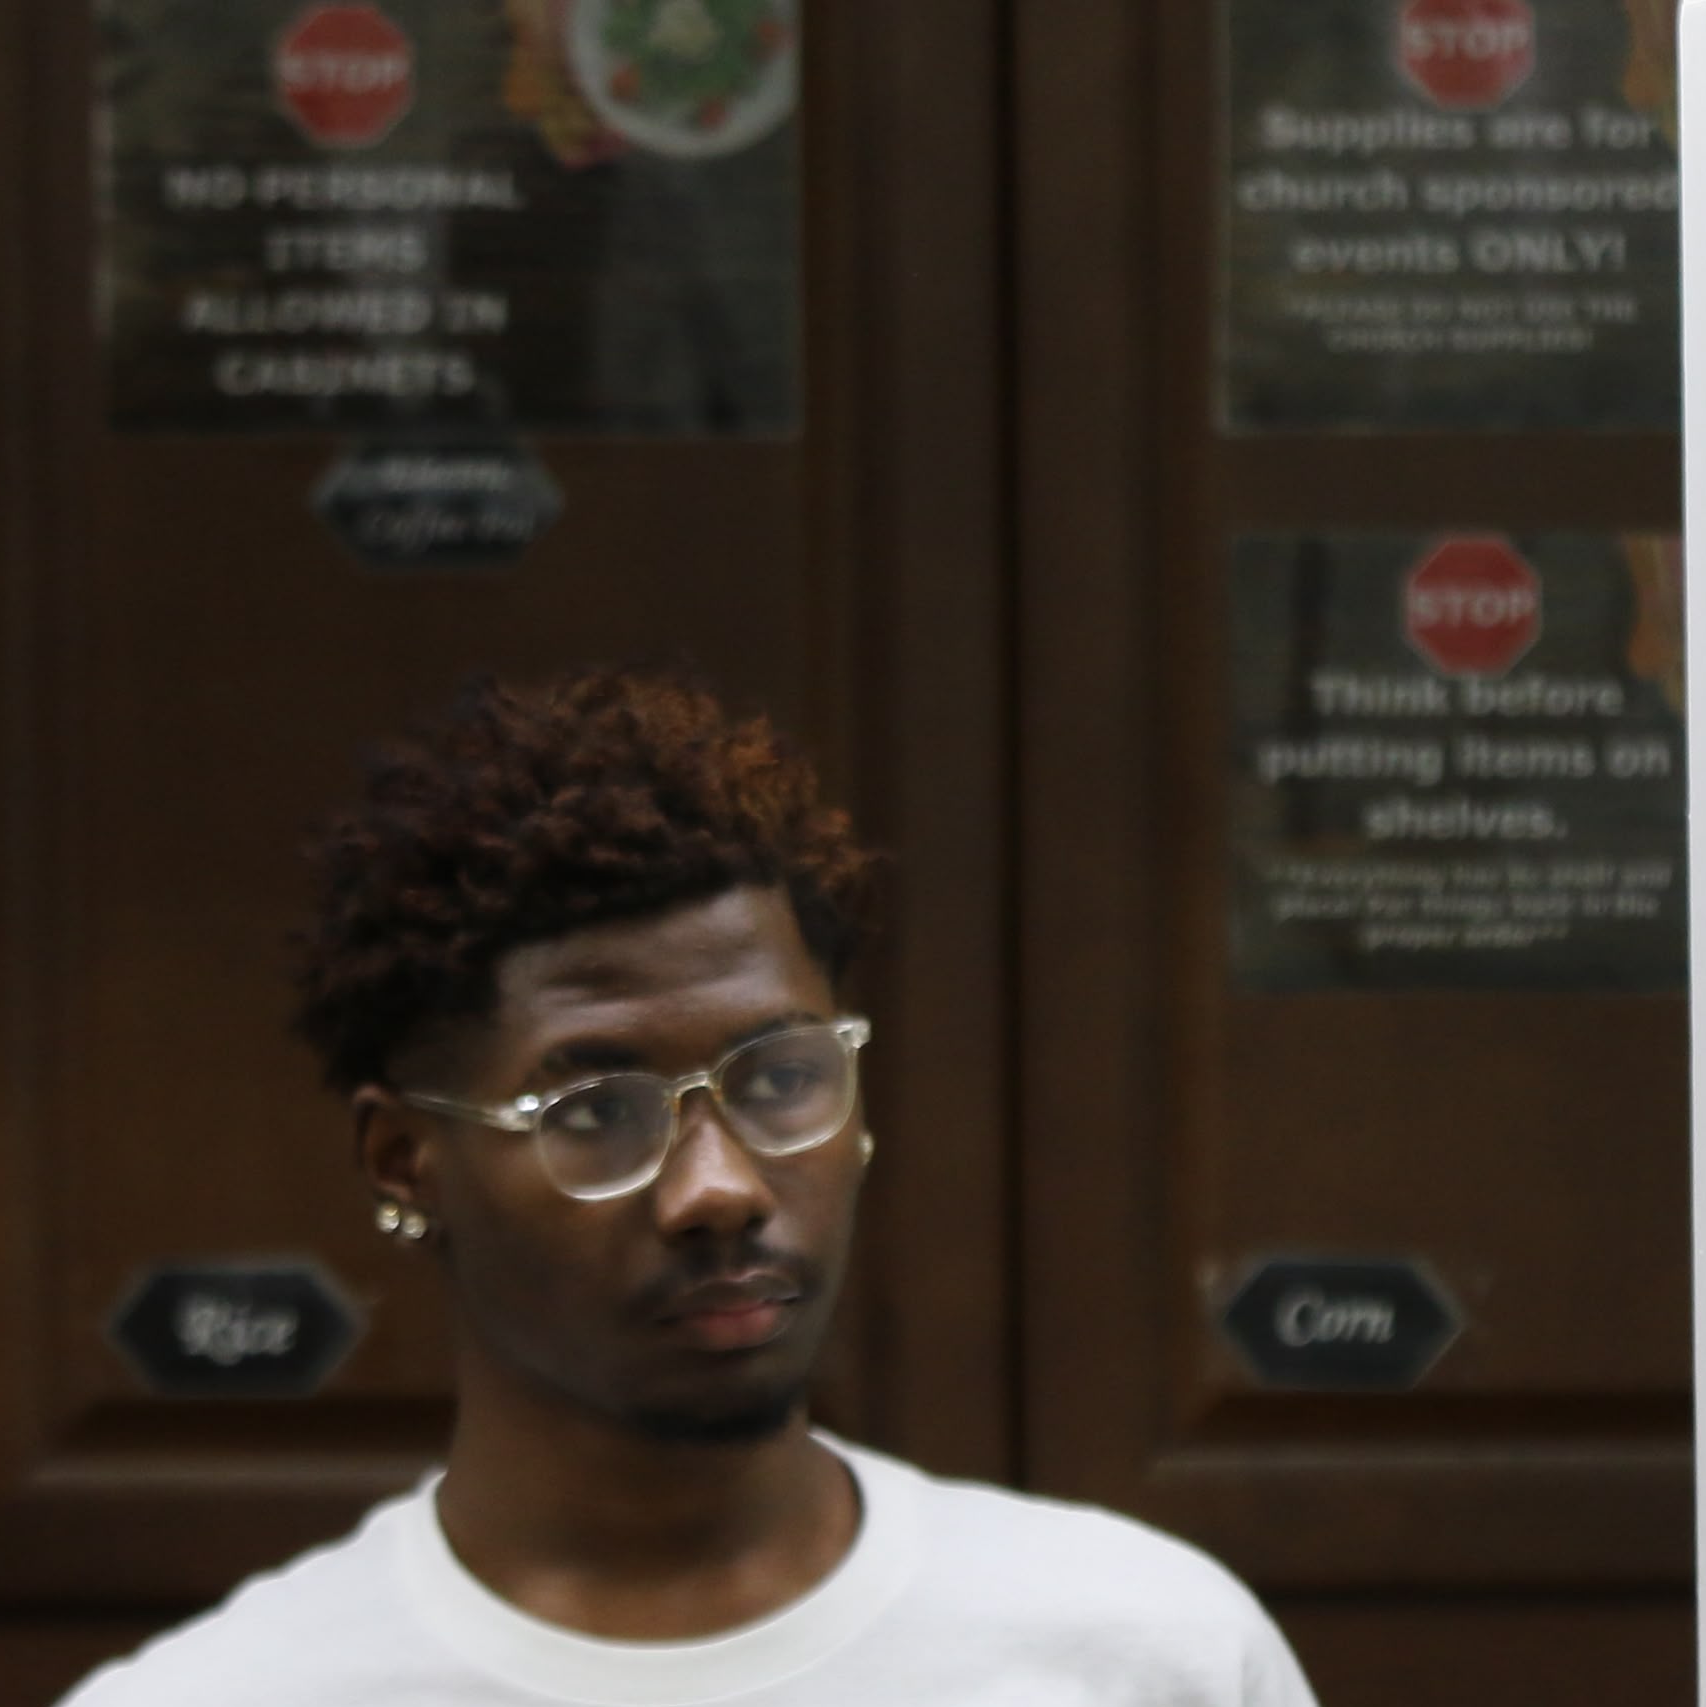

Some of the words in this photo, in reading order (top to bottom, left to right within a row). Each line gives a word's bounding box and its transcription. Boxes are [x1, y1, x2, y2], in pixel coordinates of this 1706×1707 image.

[1401, 20, 1529, 60] STOP
[1262, 104, 1476, 155] Supplies
[1485, 113, 1572, 150] are
[1579, 107, 1654, 150] for
[1238, 170, 1410, 212] church
[1291, 232, 1460, 273] events
[1469, 227, 1627, 273] ONLY!
[1410, 590, 1536, 629] STOP
[1311, 673, 1449, 717] Think
[1460, 673, 1625, 718] before
[1256, 735, 1443, 785] putting
[1453, 733, 1596, 779] items
[1605, 741, 1671, 779] on
[1361, 794, 1568, 840] shelves.
[1276, 1284, 1394, 1347] Corn
